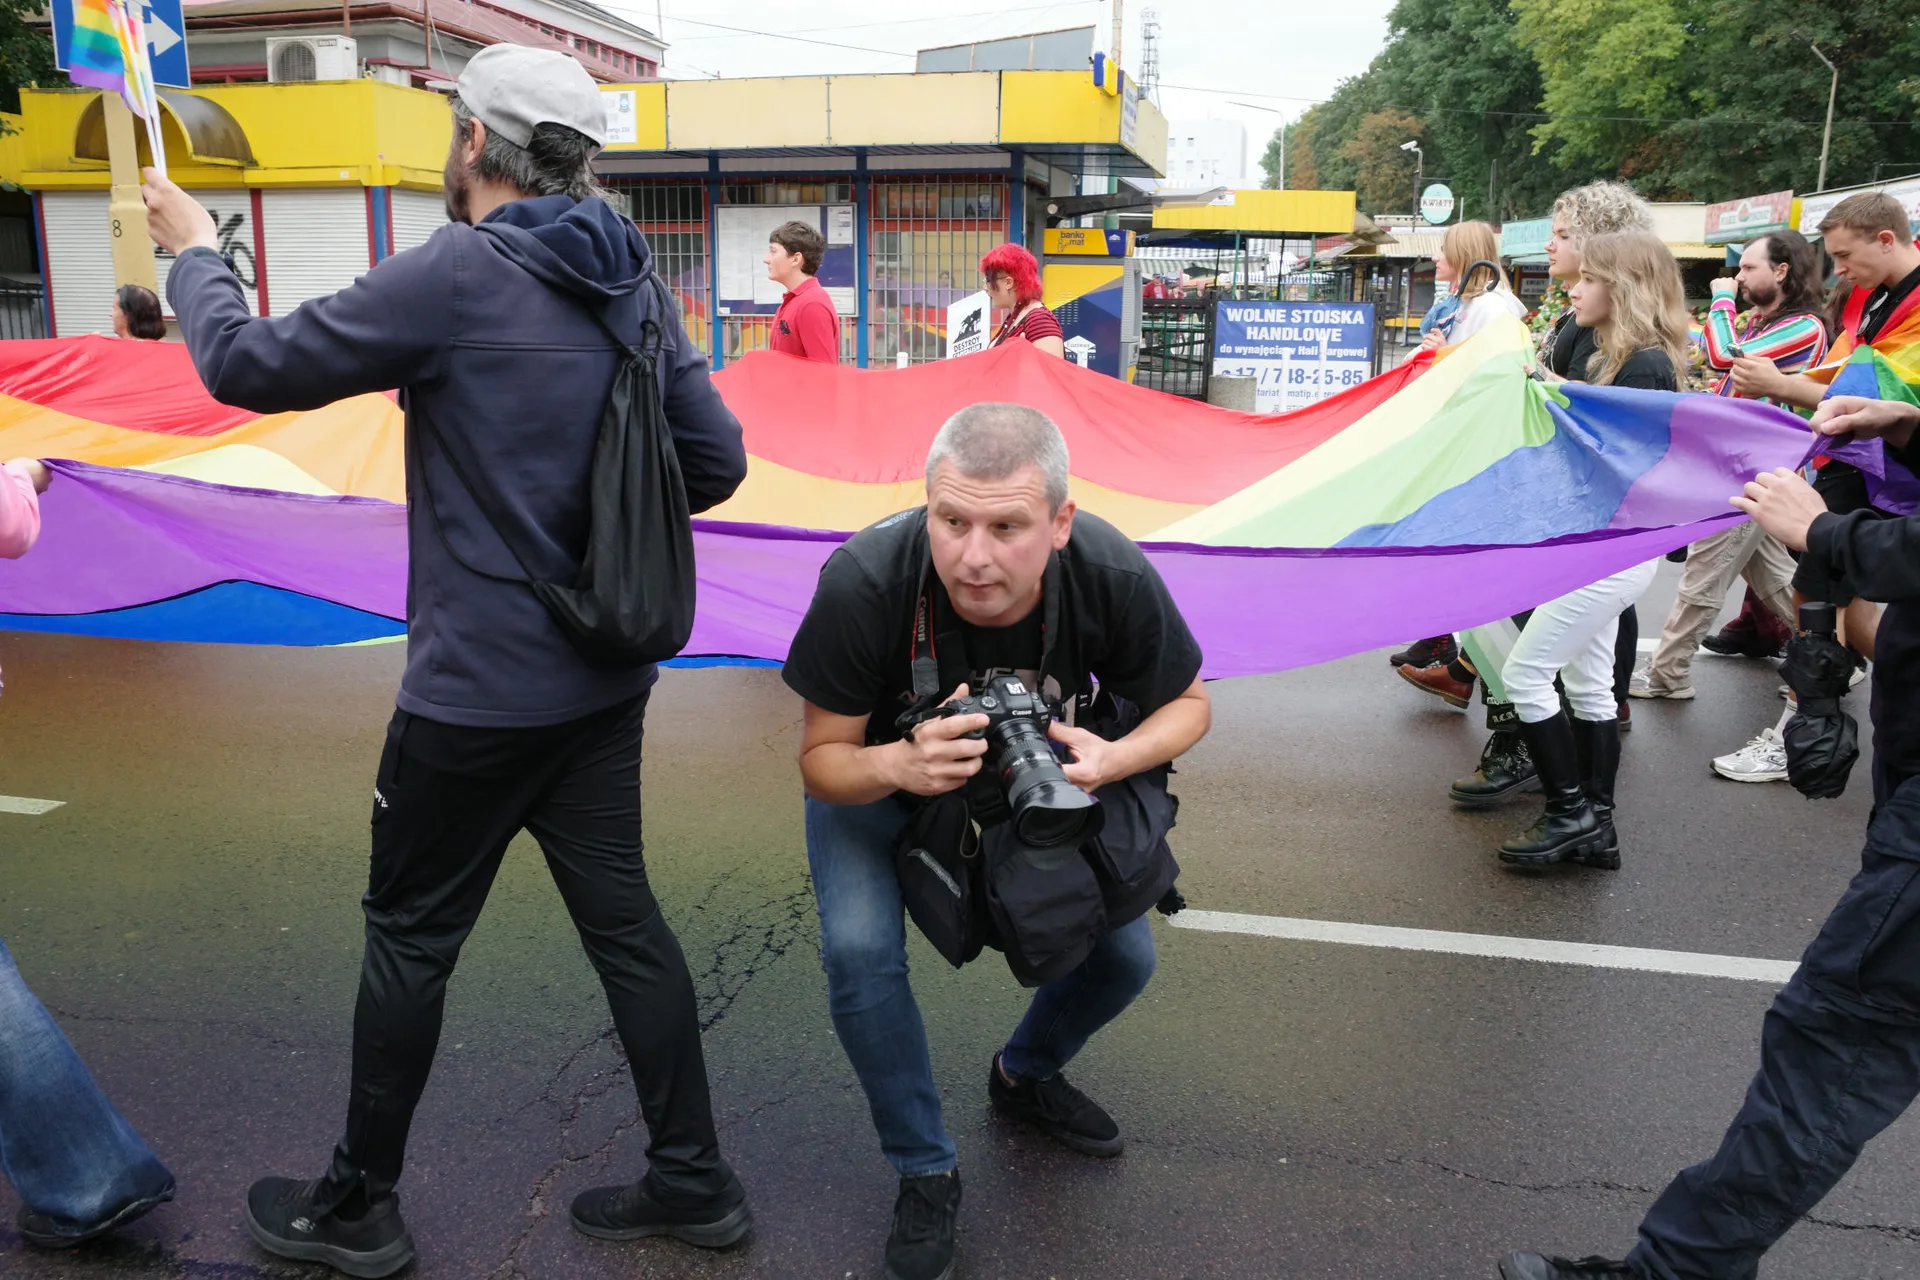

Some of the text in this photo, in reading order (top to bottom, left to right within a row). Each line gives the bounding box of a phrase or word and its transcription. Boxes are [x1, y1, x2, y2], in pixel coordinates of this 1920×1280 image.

[1422, 198, 1453, 208] KWIATY
[112, 219, 122, 238] 8
[1060, 231, 1085, 239] banko
[1226, 308, 1365, 324] WOLNE STOISKA
[1246, 326, 1342, 342] HANDLOWE
[953, 335, 980, 353] DESTROY
[1220, 344, 1232, 354] do
[1234, 344, 1284, 356] wynajęcia
[1298, 346, 1318, 356] Hali
[1326, 347, 1368, 358] argowej
